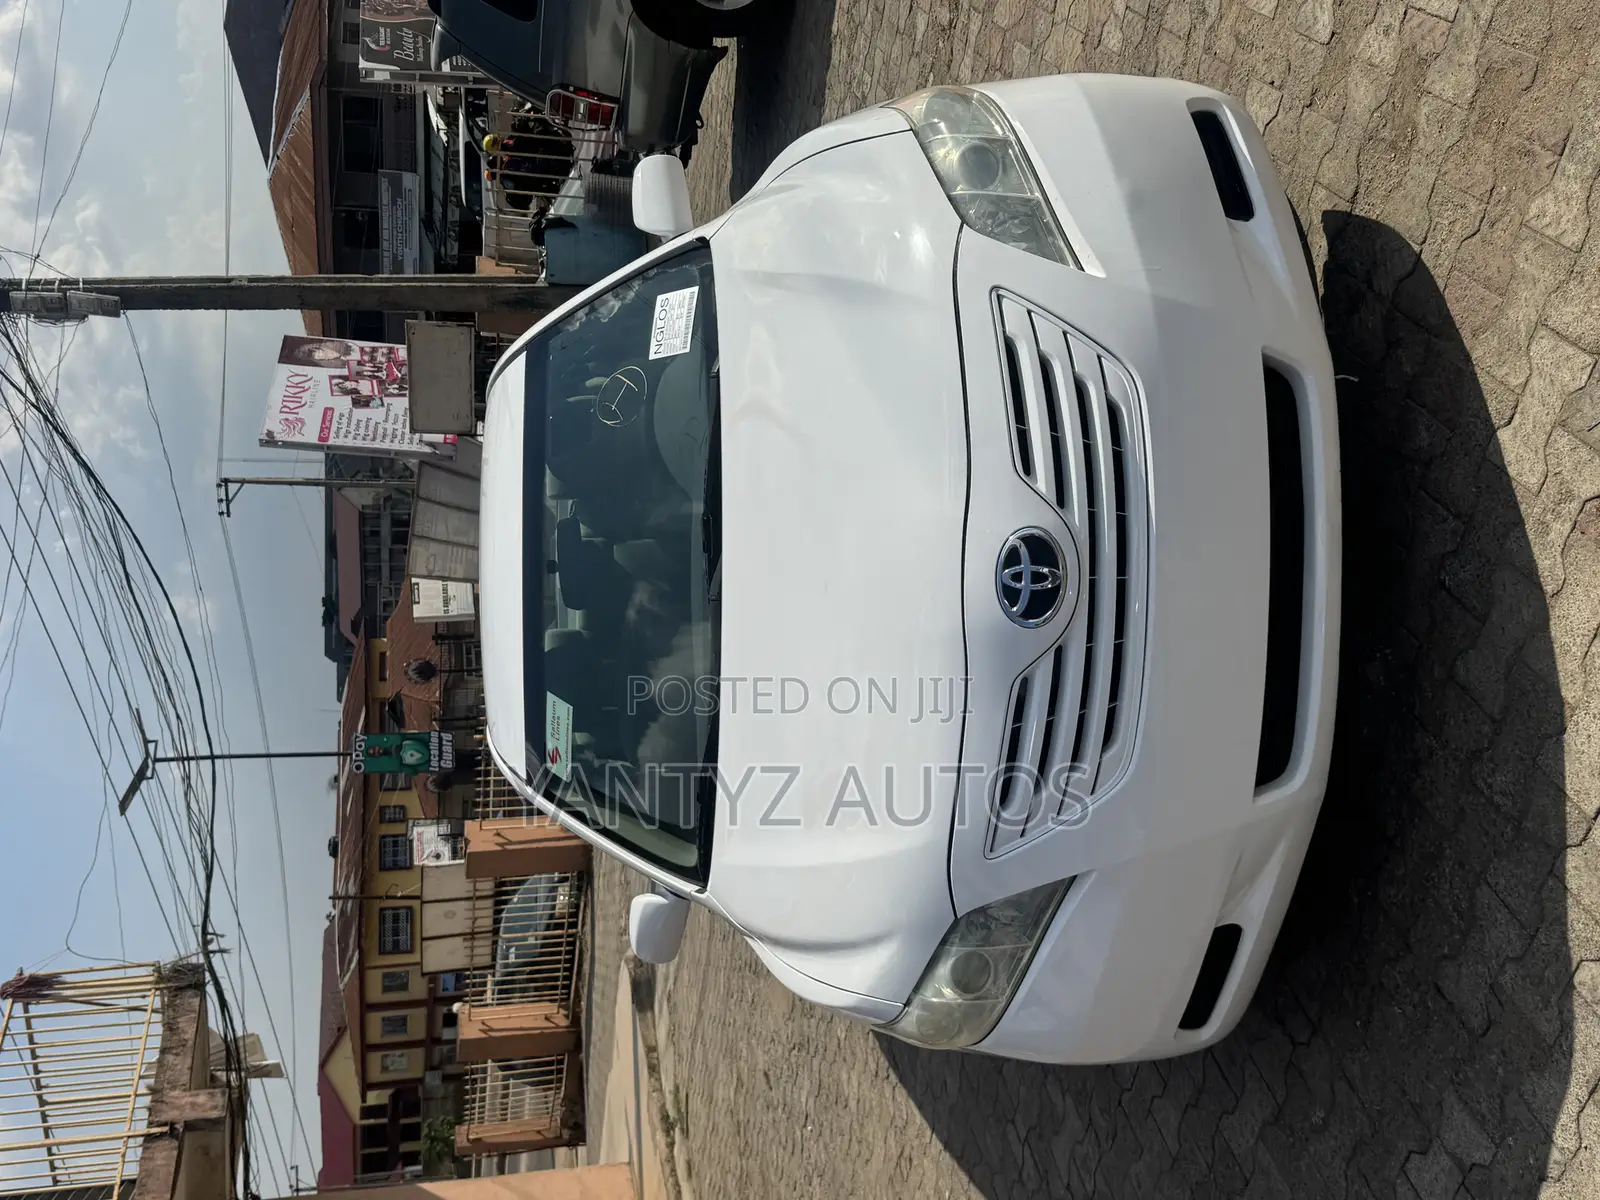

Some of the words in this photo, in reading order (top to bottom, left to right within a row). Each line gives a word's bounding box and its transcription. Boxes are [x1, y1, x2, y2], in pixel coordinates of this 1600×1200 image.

[393, 28, 431, 61] Beauty
[653, 298, 670, 354] NGLOS
[278, 368, 313, 416] RIKKY
[308, 379, 320, 408] HAIRLINE
[320, 428, 329, 438] Our
[333, 426, 343, 439] Selling
[343, 429, 351, 438] Wigs
[354, 419, 362, 432] Styling
[379, 427, 388, 443] Ponytail
[441, 583, 449, 608] AVAILABLE
[352, 732, 368, 774] OPay
[429, 731, 439, 771] Location
[440, 732, 453, 768] Guard
